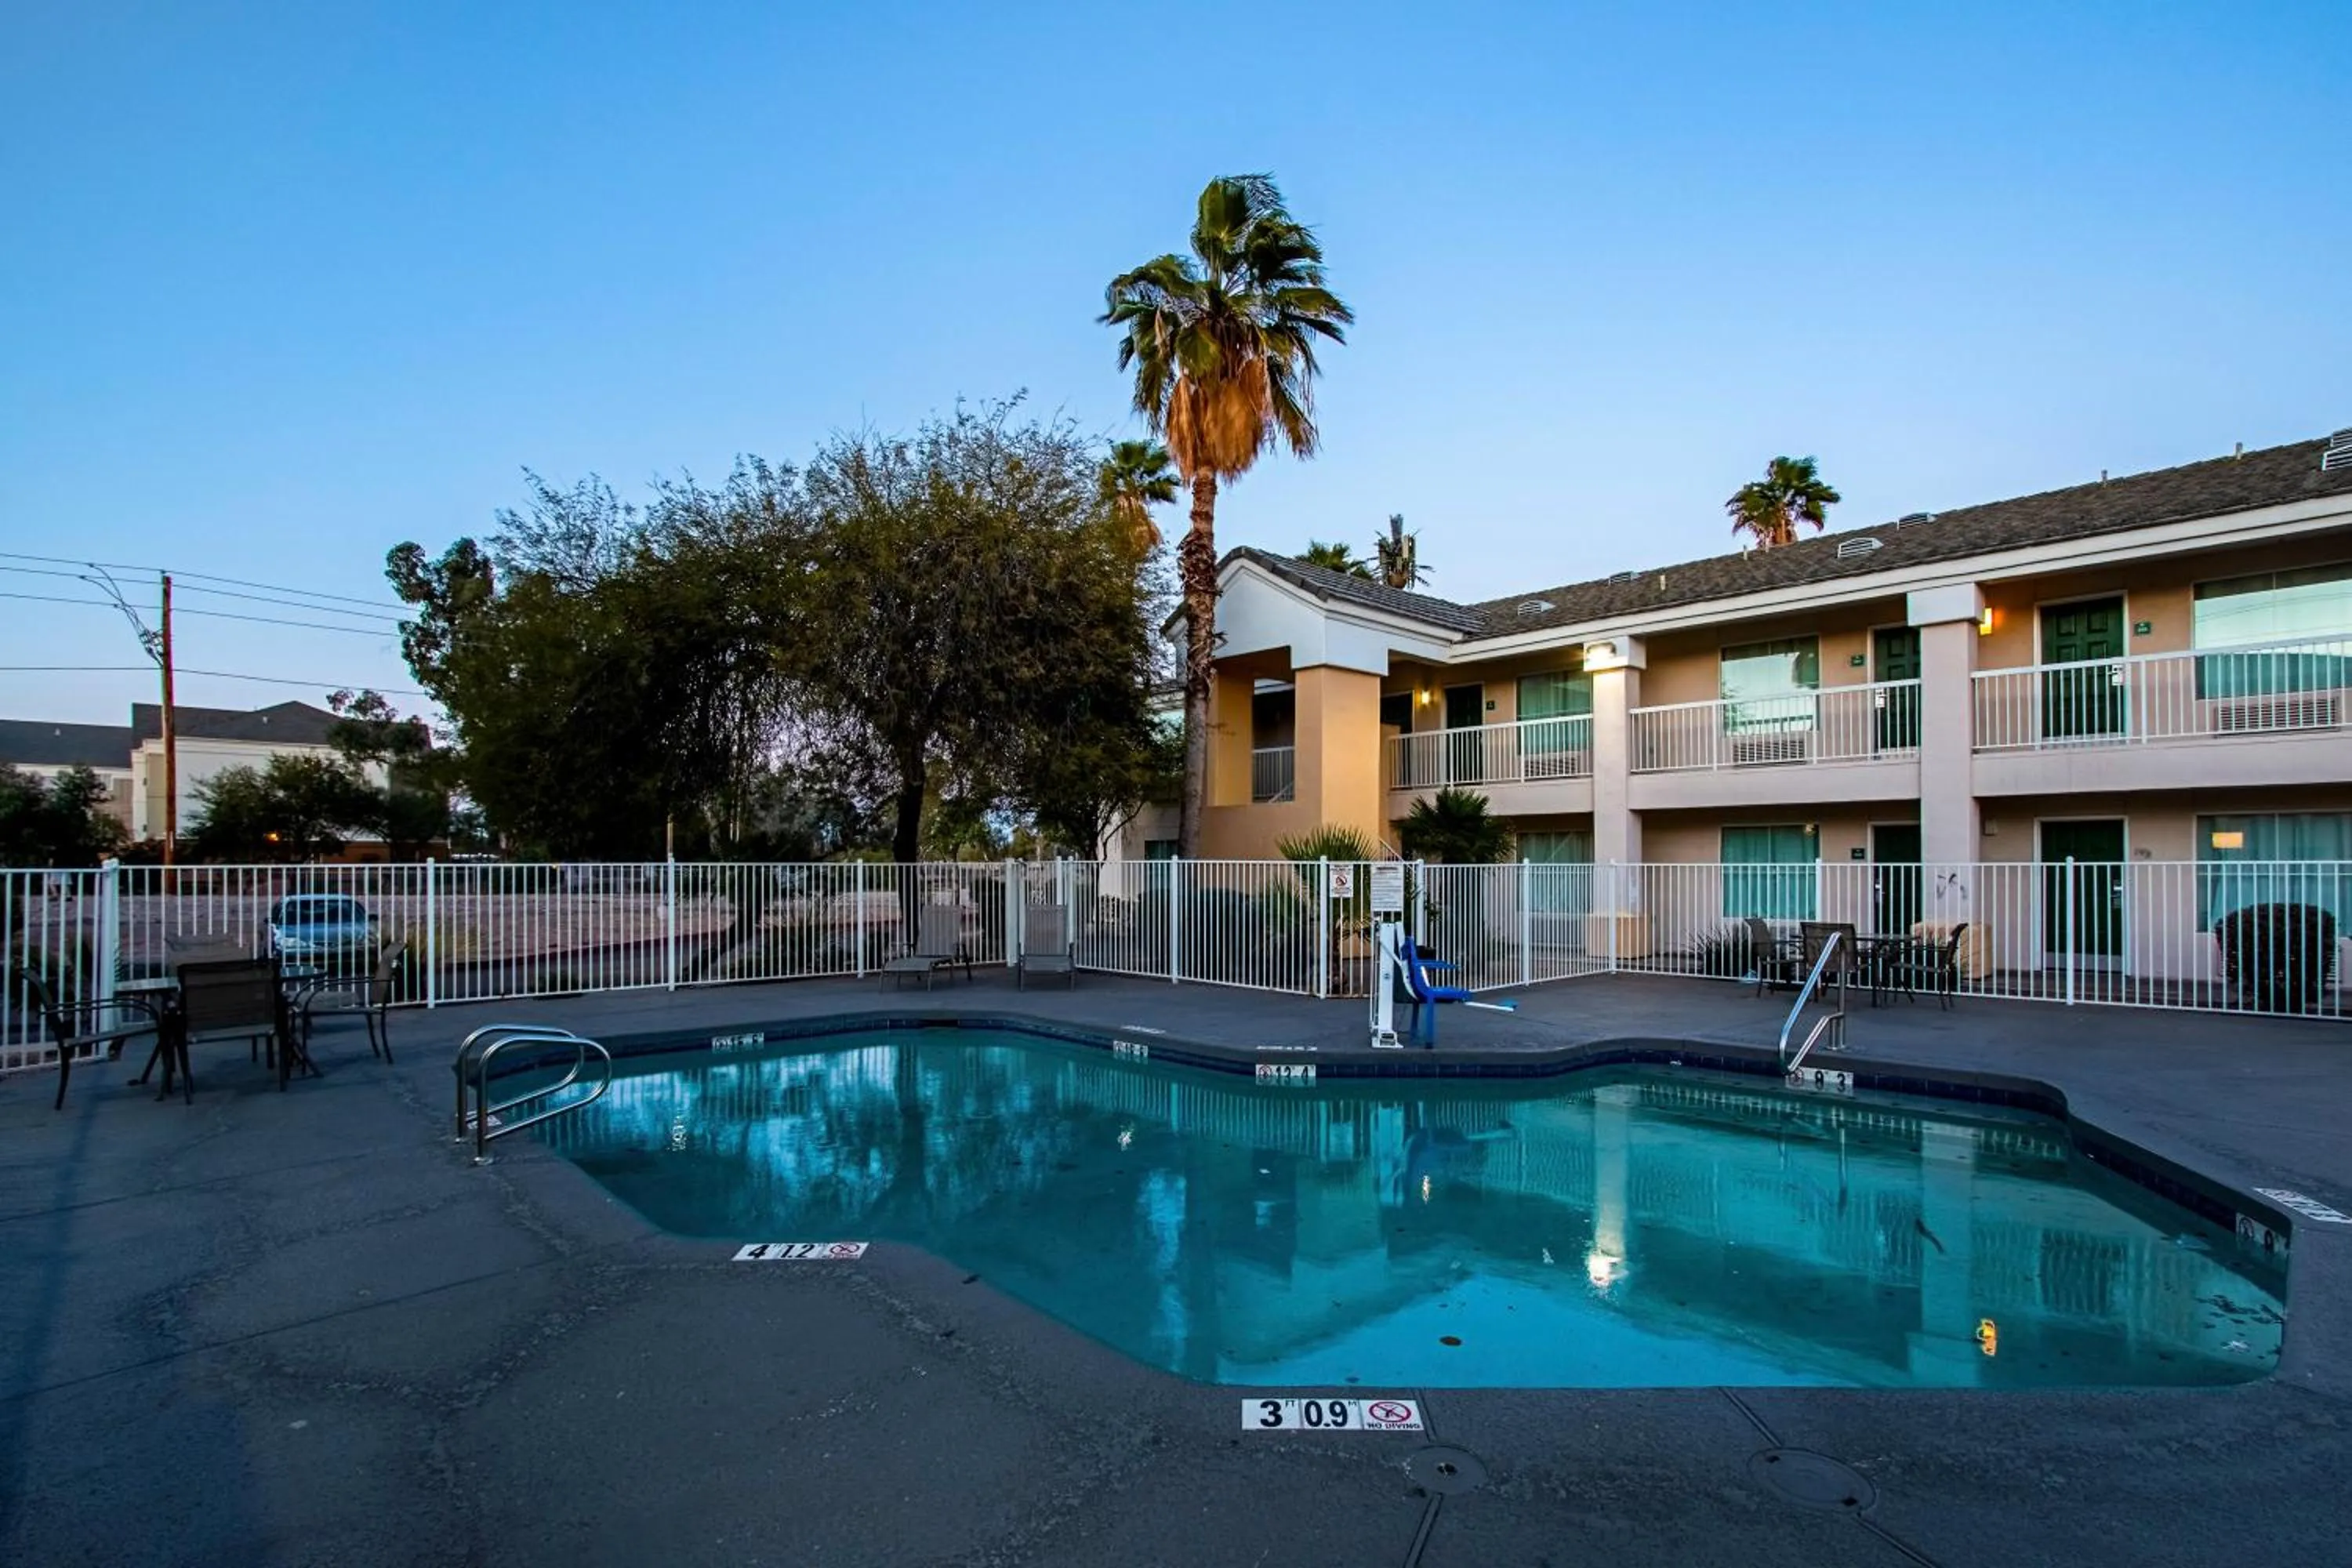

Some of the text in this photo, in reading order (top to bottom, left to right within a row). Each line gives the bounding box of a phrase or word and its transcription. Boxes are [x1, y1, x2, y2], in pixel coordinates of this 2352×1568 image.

[747, 1244, 770, 1258] 4
[1260, 1399, 1283, 1427] 3
[1304, 1399, 1348, 1428] 0.9
